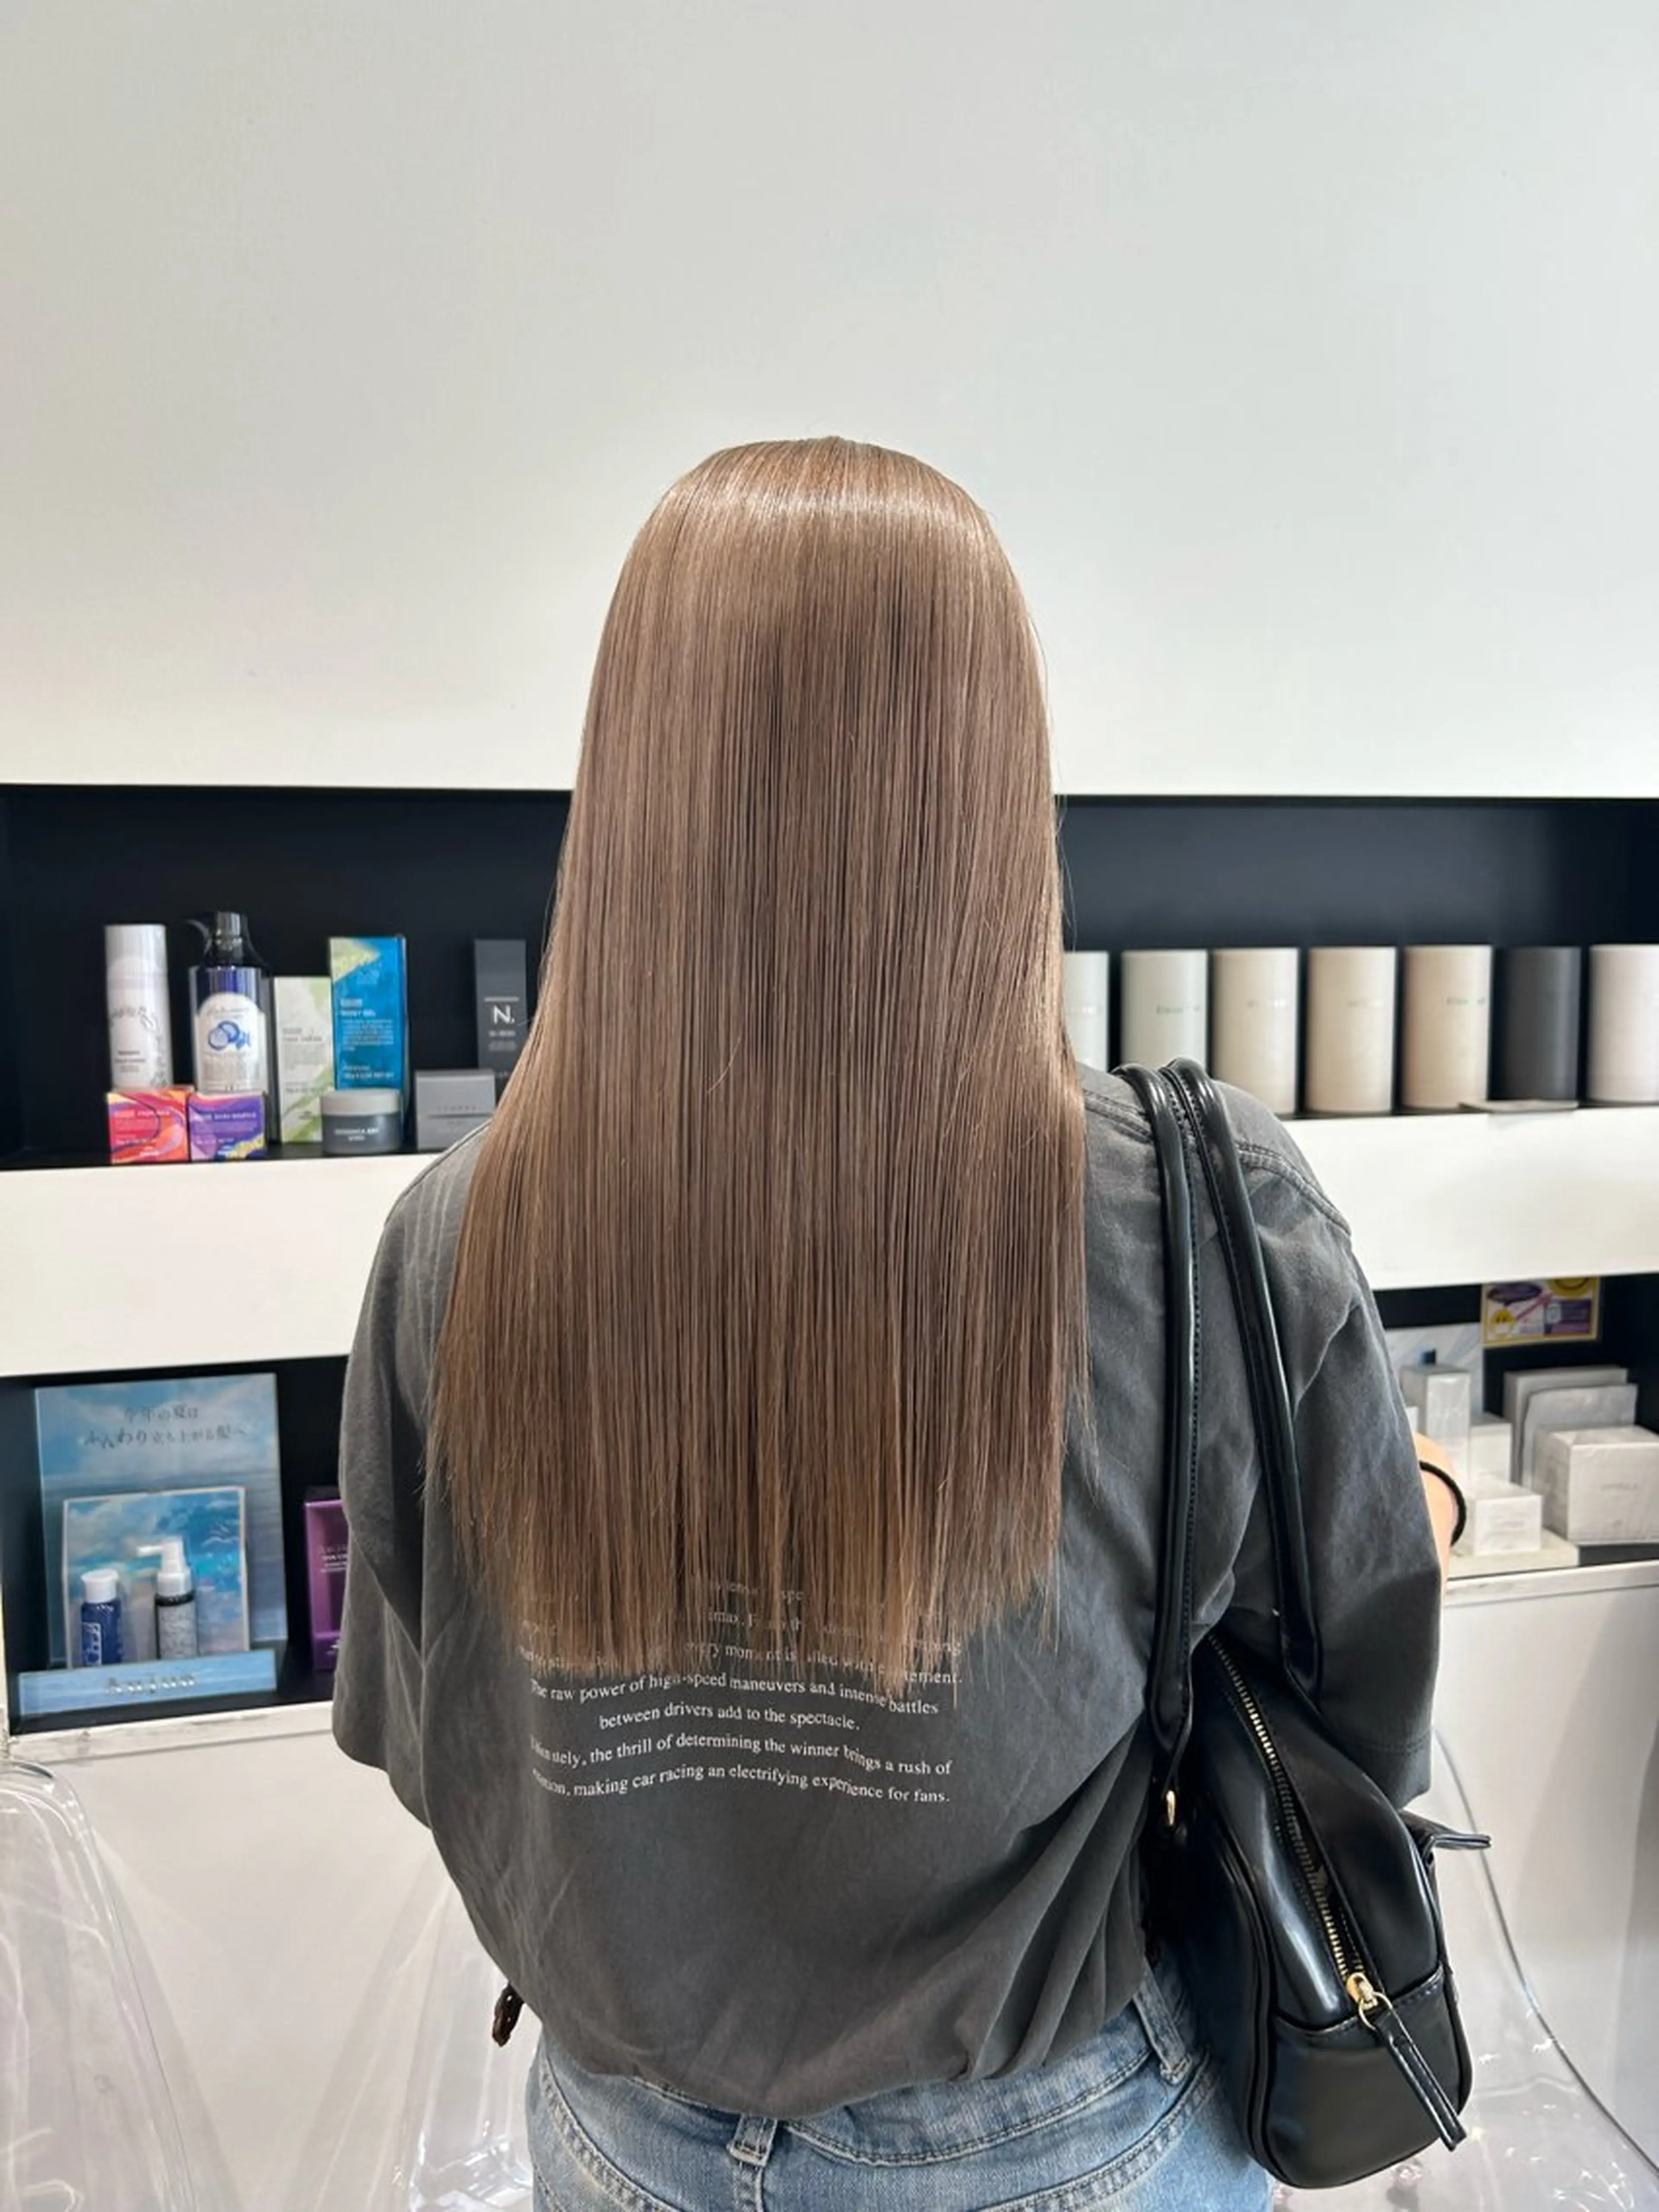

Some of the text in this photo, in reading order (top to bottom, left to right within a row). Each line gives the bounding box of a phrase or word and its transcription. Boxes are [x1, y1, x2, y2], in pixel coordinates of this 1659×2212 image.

[493, 1004, 515, 1024] N.
[550, 1688, 575, 1701] raw
[579, 1683, 626, 1703] power
[629, 1675, 646, 1693] of
[730, 1677, 806, 1694] maneuvers
[810, 1681, 836, 1696] and
[888, 1694, 939, 1715] battles
[599, 1701, 861, 1731] between drivers add to the spectacle.
[590, 1748, 613, 1763] the
[617, 1737, 652, 1758] thrill
[656, 1733, 674, 1750] of
[676, 1732, 762, 1754] determining
[764, 1737, 786, 1753] the
[790, 1740, 840, 1757] winner
[842, 1744, 881, 1772] brings
[885, 1761, 895, 1772] a
[898, 1760, 931, 1775] rush
[934, 1759, 953, 1775] of
[573, 1778, 628, 1796] making
[632, 1773, 657, 1789] car
[659, 1763, 704, 1781] racing
[708, 1766, 726, 1779] an
[728, 1763, 809, 1790] electrifying
[812, 1775, 884, 1799] experience
[887, 1786, 910, 1802] for
[913, 1789, 950, 1803] fans.
